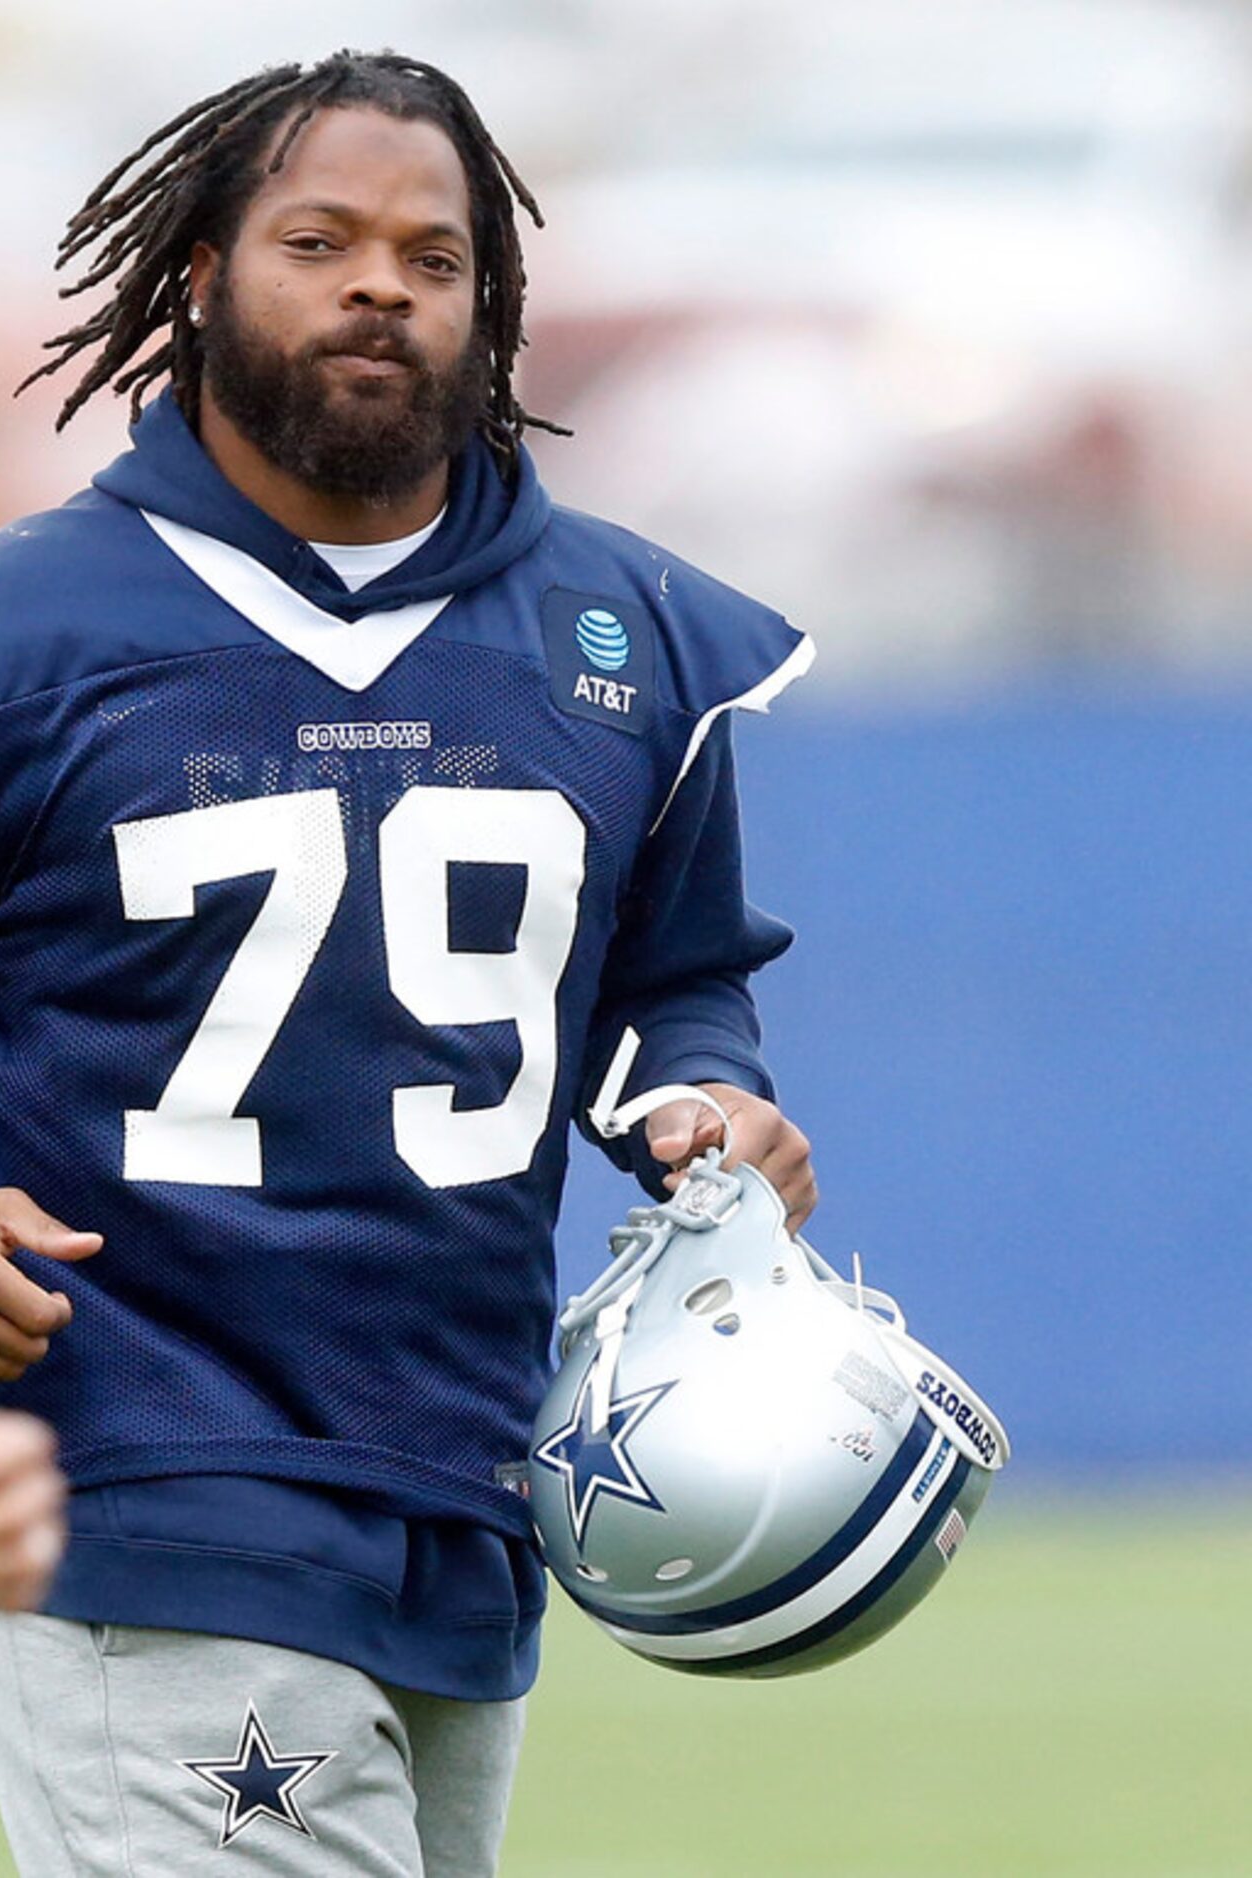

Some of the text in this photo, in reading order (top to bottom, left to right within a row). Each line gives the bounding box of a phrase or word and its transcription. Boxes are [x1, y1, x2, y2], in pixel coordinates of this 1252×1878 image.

[573, 673, 637, 714] AT&T
[297, 722, 432, 752] COWBOYS
[112, 785, 587, 1189] 79
[915, 1371, 997, 1464] COWBOYS
